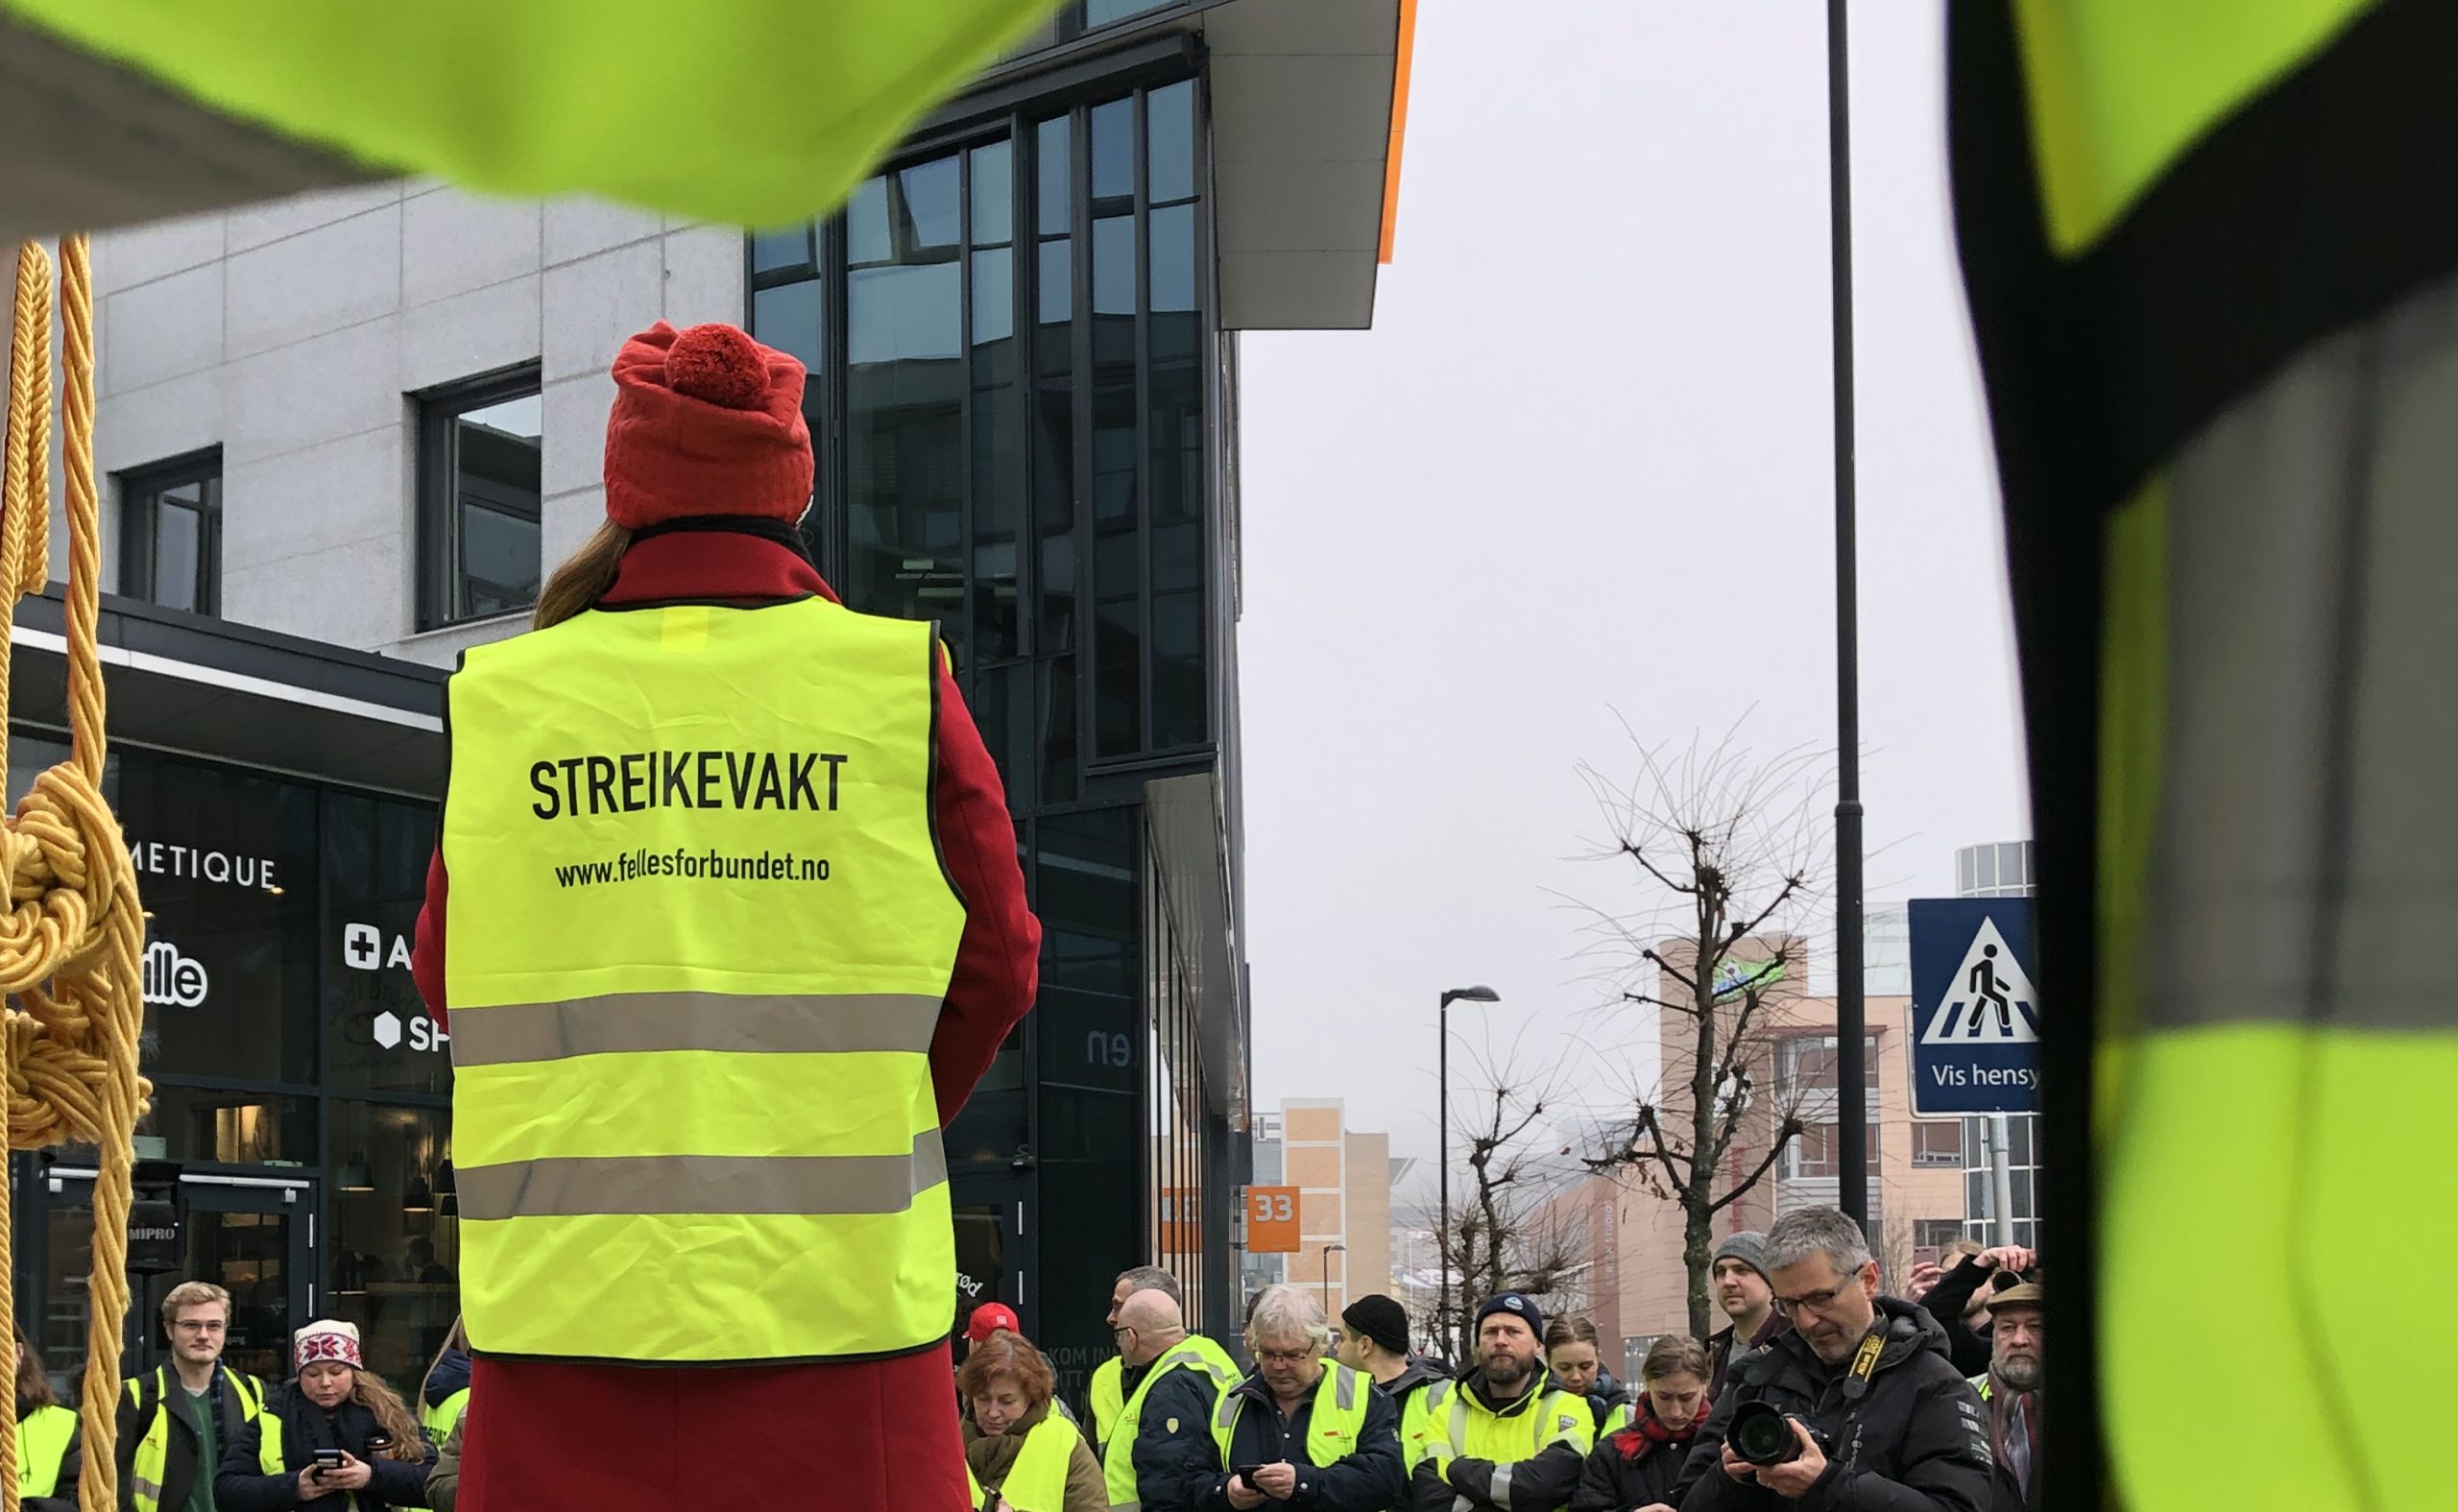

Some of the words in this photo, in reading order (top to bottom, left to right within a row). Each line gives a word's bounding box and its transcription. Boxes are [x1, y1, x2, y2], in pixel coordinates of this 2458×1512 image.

[530, 751, 848, 820] STREIKEVAKT
[555, 848, 830, 887] www.fellesforbundet.no
[1932, 1065, 1966, 1087] Vis
[1254, 1194, 1293, 1222] 33
[1048, 1347, 1087, 1365] KOM
